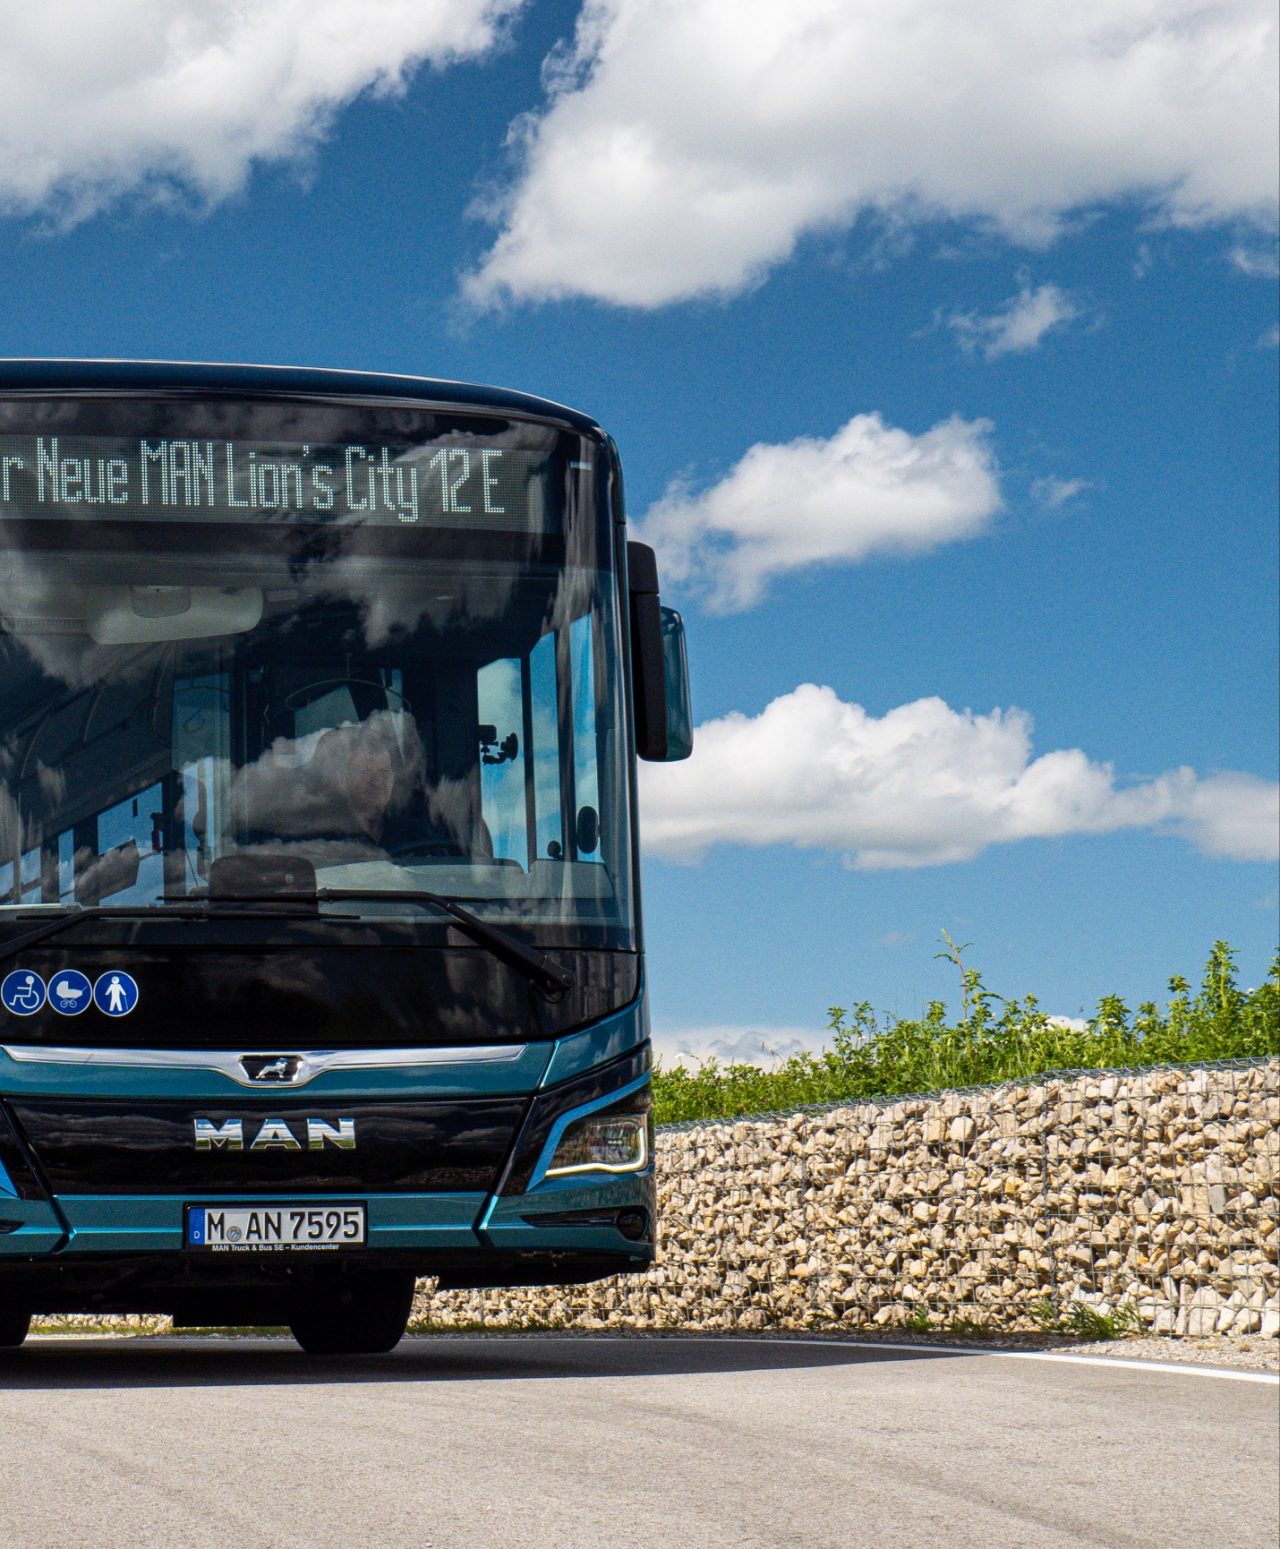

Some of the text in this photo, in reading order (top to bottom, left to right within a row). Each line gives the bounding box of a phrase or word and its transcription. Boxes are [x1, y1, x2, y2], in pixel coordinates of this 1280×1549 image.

[36, 437, 128, 504] Neue
[141, 439, 214, 506] MAN
[226, 441, 333, 510] Lion's
[346, 446, 418, 522] City
[430, 449, 472, 512] 12
[485, 450, 505, 513] E
[194, 1118, 356, 1150] MAN
[193, 1210, 360, 1240] D M AN 7595
